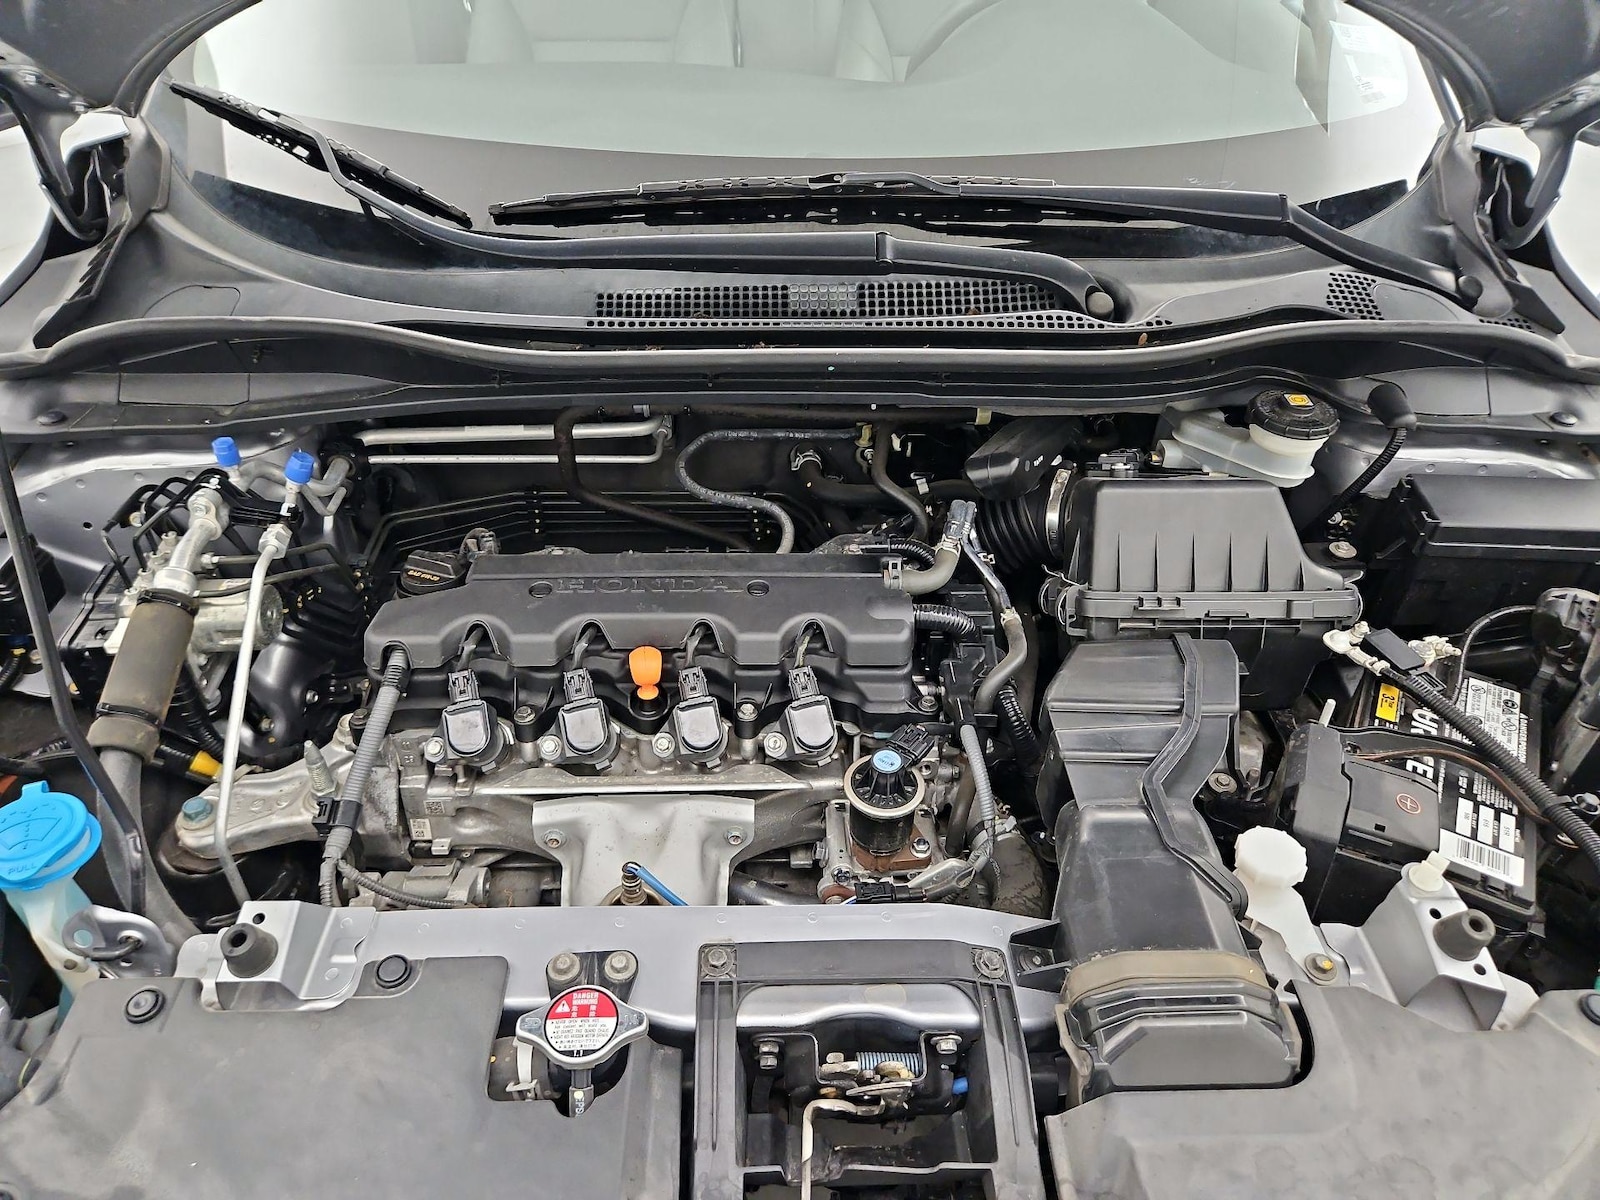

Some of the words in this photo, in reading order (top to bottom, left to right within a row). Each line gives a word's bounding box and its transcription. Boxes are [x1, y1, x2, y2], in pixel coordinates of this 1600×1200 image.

[556, 578, 744, 593] HONDA
[1381, 693, 1390, 701] 3
[8, 863, 37, 875] PULL
